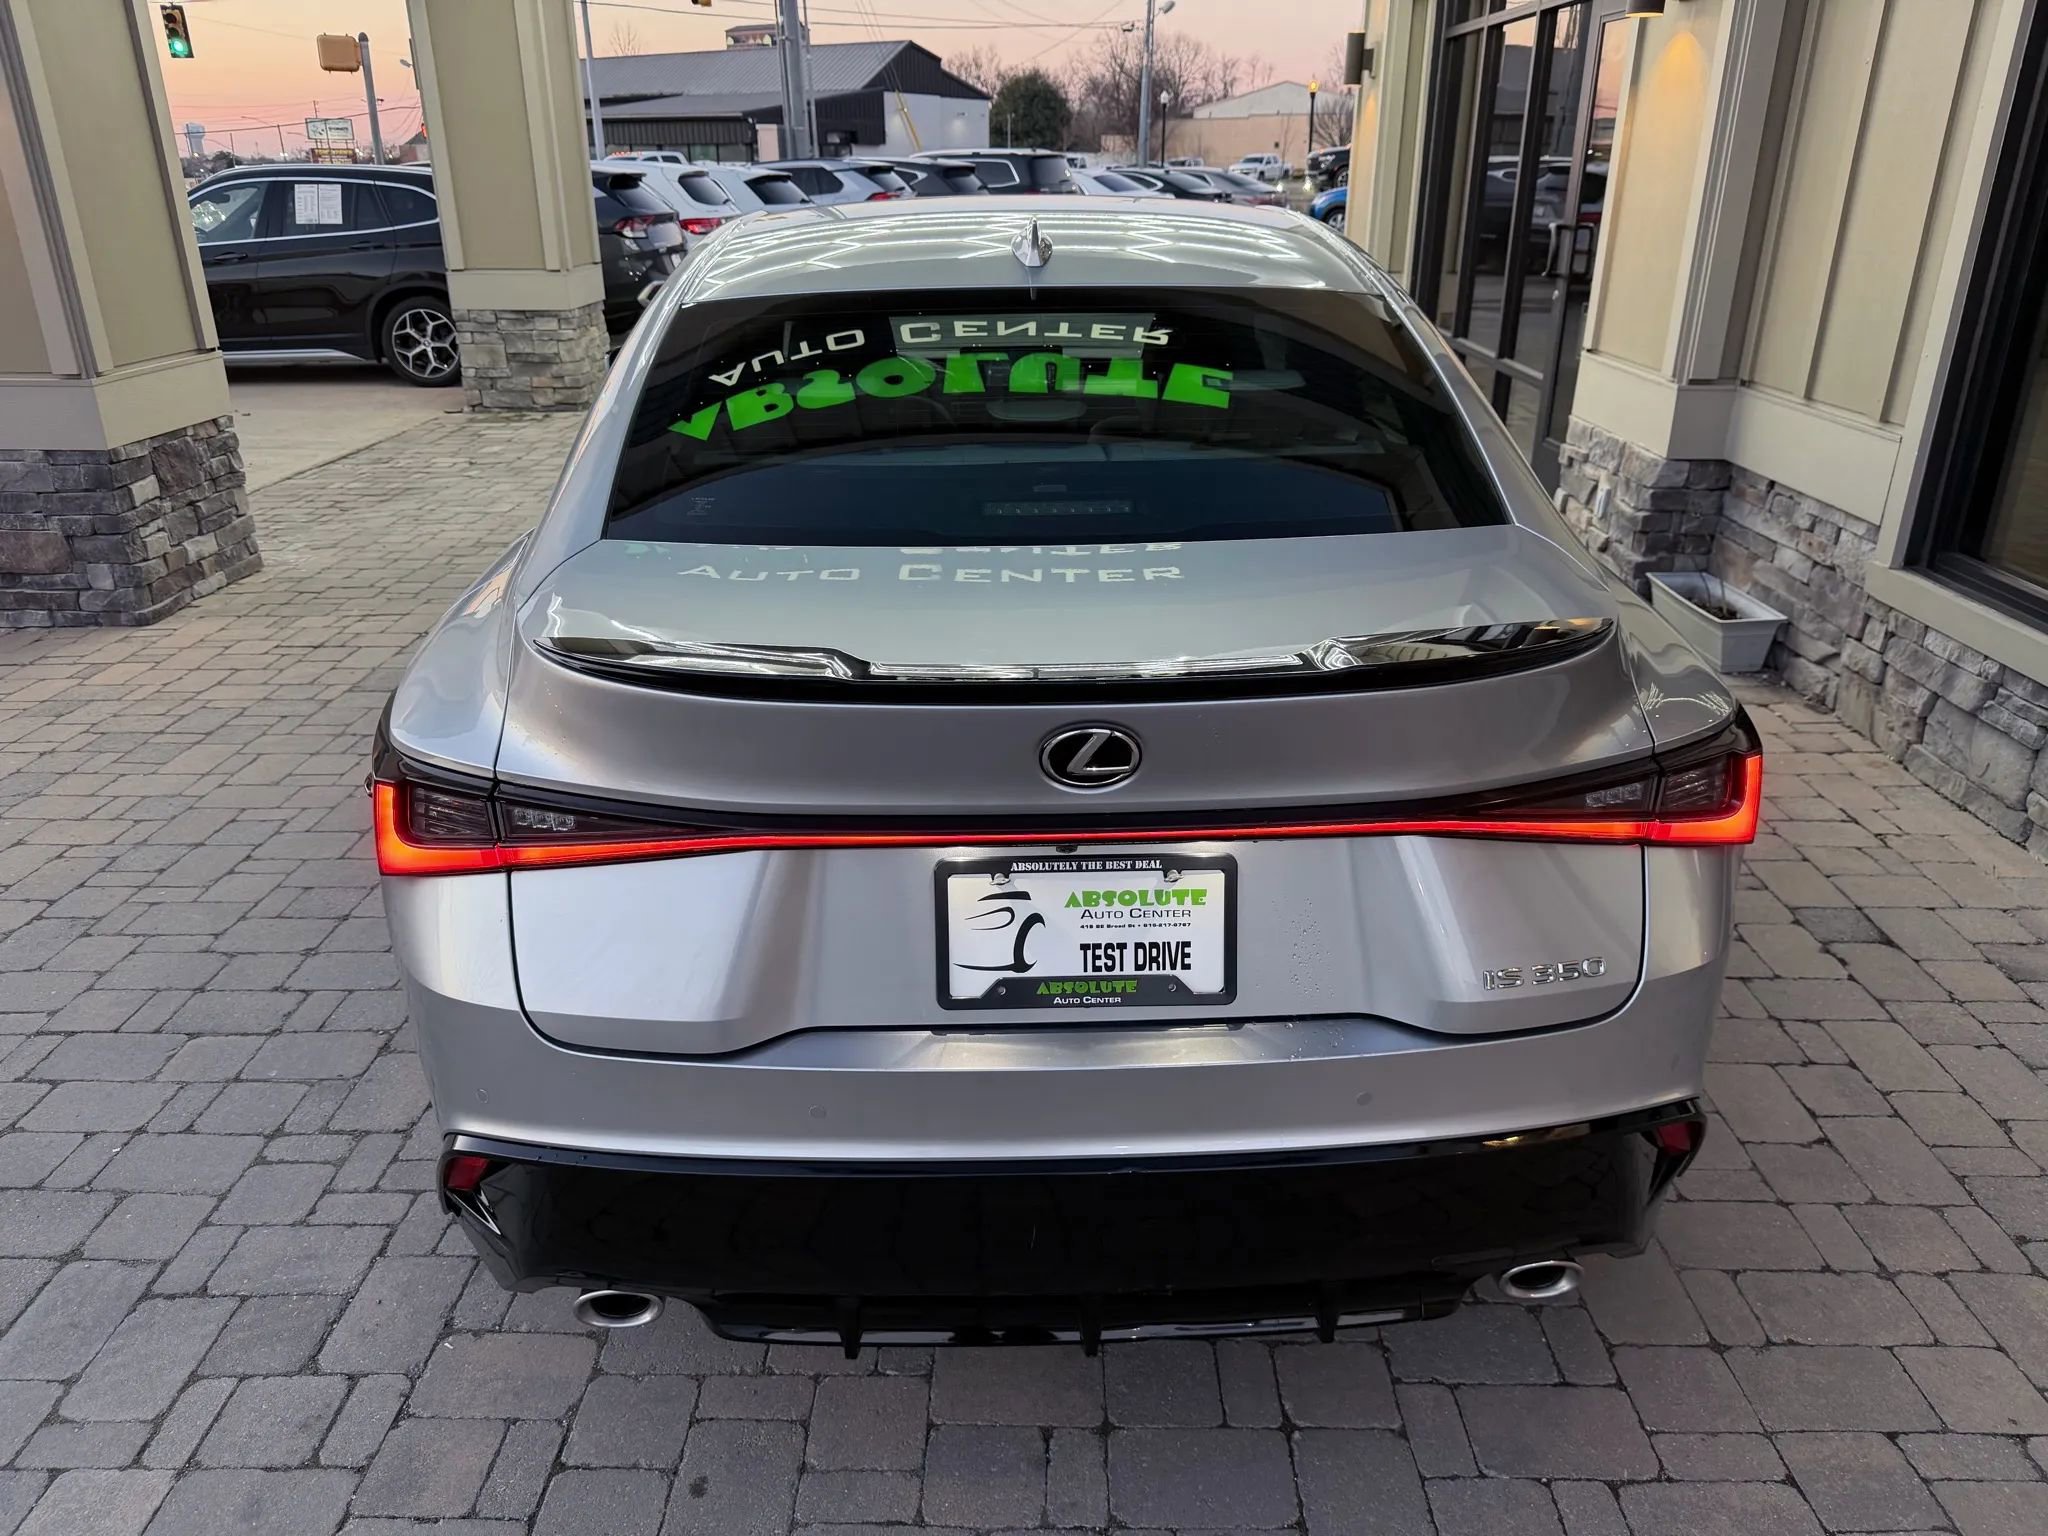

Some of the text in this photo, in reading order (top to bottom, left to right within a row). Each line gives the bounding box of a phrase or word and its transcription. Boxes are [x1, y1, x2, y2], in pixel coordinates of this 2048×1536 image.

[677, 563, 1185, 583] AUTO CENTER
[1010, 859, 1163, 872] ABSOLUTELY THE BEST DEAL
[1064, 888, 1208, 908] ABSOLUTE
[1080, 907, 1192, 920] AUTO CENTER
[1080, 940, 1192, 973] TEST DRIVE
[1483, 956, 1607, 991] IS 350
[1036, 980, 1138, 995] ABSOLUTE
[1082, 996, 1122, 1004] CENTER
